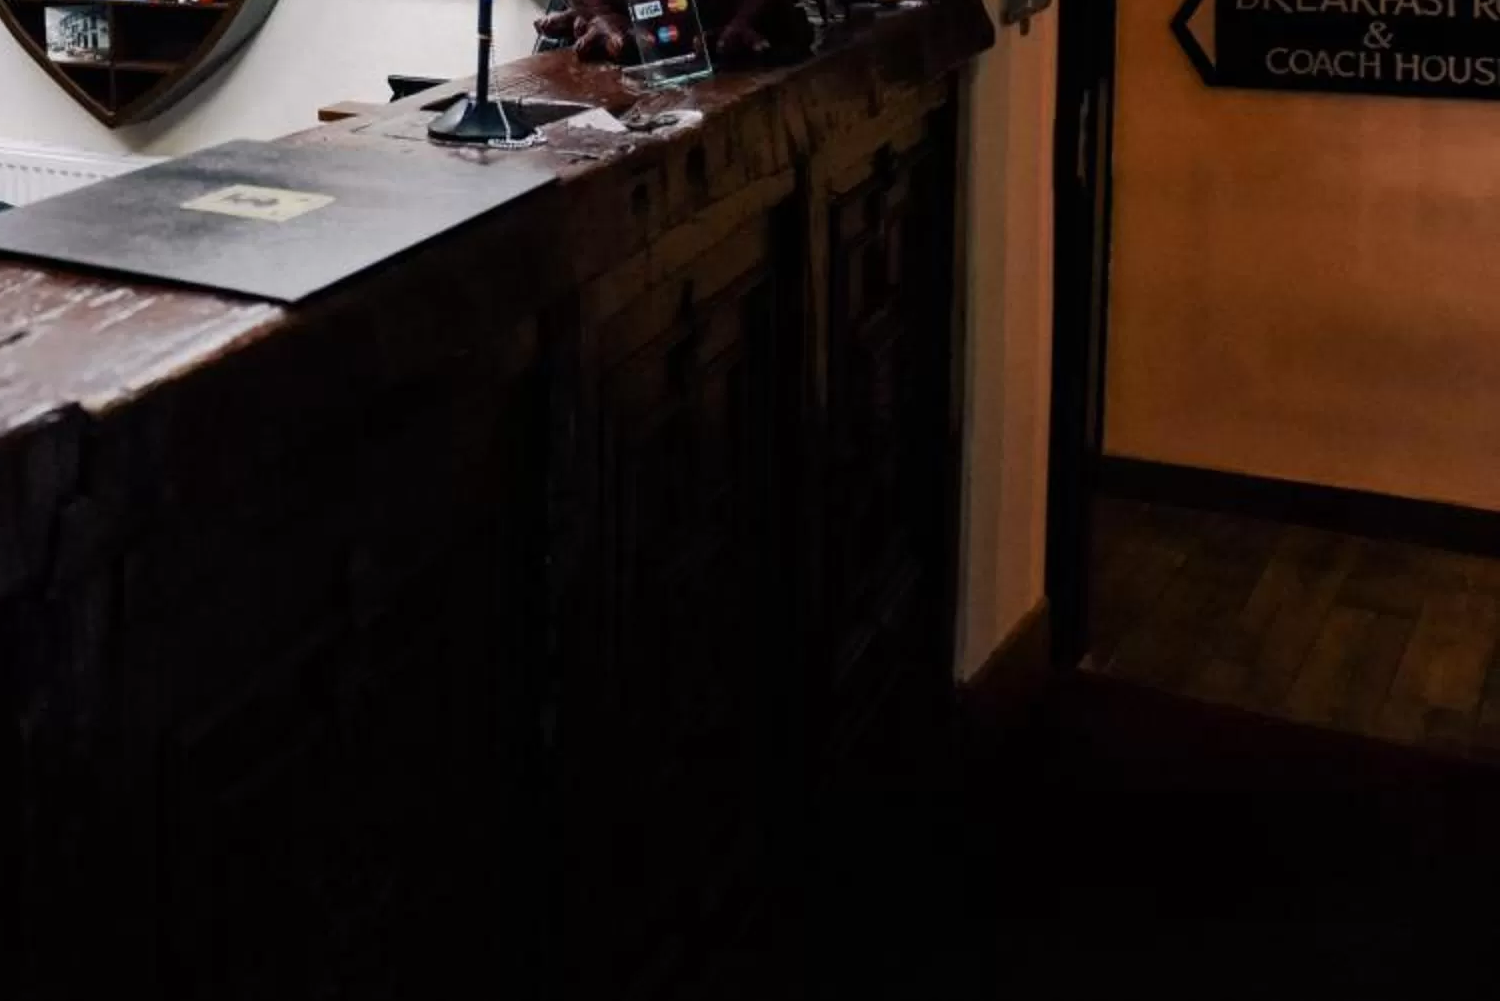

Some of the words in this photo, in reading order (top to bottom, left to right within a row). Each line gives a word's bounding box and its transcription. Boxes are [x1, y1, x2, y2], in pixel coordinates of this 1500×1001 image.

[636, 2, 661, 17] VISA
[1363, 21, 1394, 50] &
[1265, 47, 1381, 80] COACH
[1394, 52, 1500, 86] HOUS
